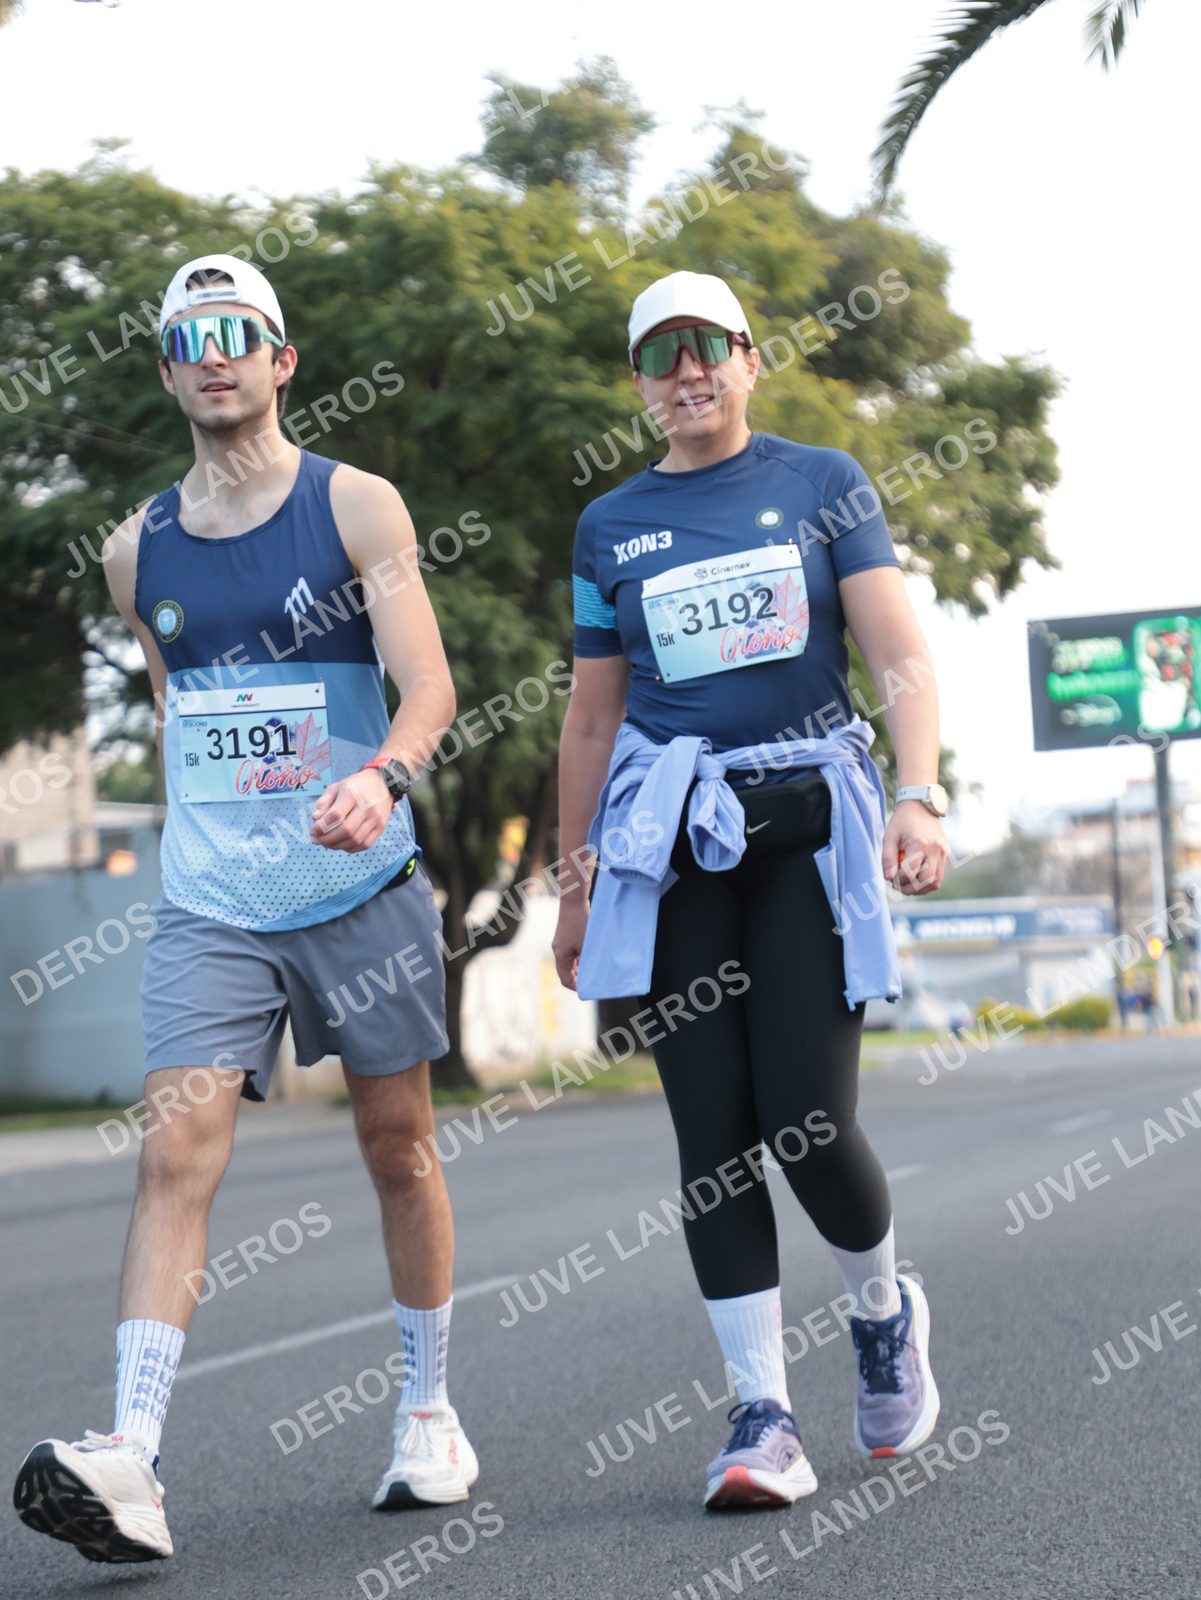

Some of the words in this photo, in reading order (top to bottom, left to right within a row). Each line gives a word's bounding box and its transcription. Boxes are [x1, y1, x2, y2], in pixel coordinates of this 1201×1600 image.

[711, 561, 751, 575] Cinemex
[678, 586, 778, 635] 3192
[206, 724, 297, 760] 3191
